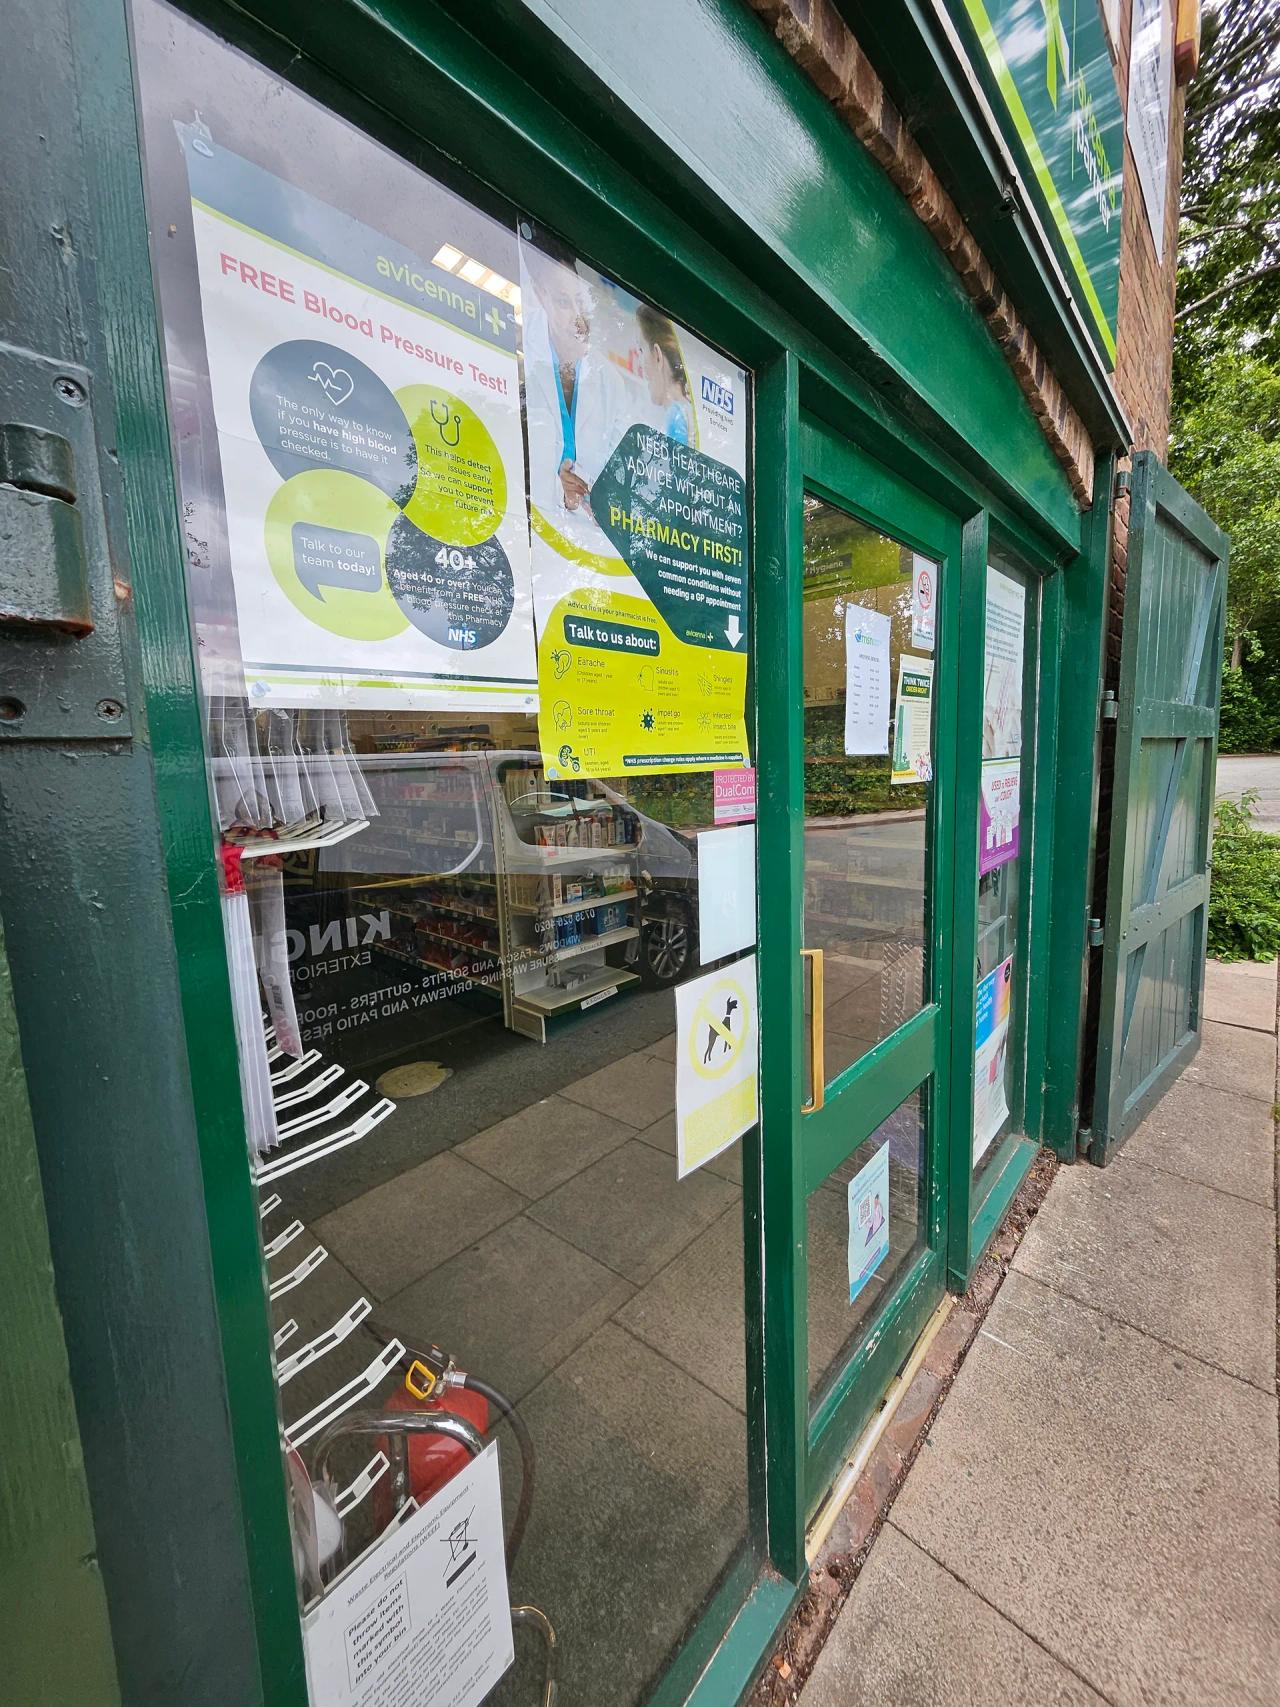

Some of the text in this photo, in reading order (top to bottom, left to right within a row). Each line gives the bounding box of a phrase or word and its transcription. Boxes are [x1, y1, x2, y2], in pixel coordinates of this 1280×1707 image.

[375, 255, 477, 319] avicenna
[219, 252, 508, 396] FREE Blood Pressure Test!
[702, 377, 733, 413] NHS
[277, 395, 393, 441] The only way to know
[277, 408, 397, 455] if you have high blood
[279, 425, 388, 464] pressure is to have it
[281, 439, 331, 461] checked.
[425, 444, 491, 472] This helps detect
[637, 432, 741, 494] NEED HEALTHCARE
[447, 464, 471, 480] issues
[438, 484, 495, 508] you to prevent
[447, 474, 461, 485] can
[463, 478, 493, 495] support
[628, 456, 742, 516] ADVICE WITHOUT AN
[454, 500, 478, 513] future
[659, 497, 742, 538] APPOINTMENT?
[301, 536, 366, 559] Talk to our
[609, 506, 742, 567] PHARMACY FIRST!
[302, 554, 376, 577] team today!
[435, 548, 477, 570] 40+
[645, 549, 742, 585] We can support you with seven
[393, 569, 418, 582] Aged
[420, 572, 434, 583] 40
[435, 576, 445, 585] or
[447, 577, 470, 589] over?
[472, 582, 486, 592] You
[658, 570, 742, 598] common conditions without
[400, 582, 431, 596] benefit
[432, 586, 453, 598] from
[463, 592, 484, 602] FREE
[486, 594, 502, 605] NHS
[663, 586, 689, 601] needing
[695, 593, 705, 602] GP
[705, 597, 742, 611] appointment
[434, 600, 469, 613] pressure
[471, 603, 493, 616] check
[495, 607, 503, 615] at
[448, 611, 463, 621] this
[567, 600, 588, 611] Advice
[602, 608, 615, 616] your
[615, 609, 641, 620] pharmacist
[448, 628, 476, 644] NHS
[569, 623, 657, 650] Talk to us about:
[685, 629, 706, 639] avicenna
[577, 657, 605, 668] Earache
[577, 707, 615, 716] Sore throat
[583, 747, 596, 756] UTI
[715, 774, 747, 784] PROTECTED
[716, 784, 755, 798] DualCom
[348, 1581, 367, 1605] Waste
[348, 1579, 403, 1636] Please do not
[352, 1594, 402, 1646] throw items
[353, 1604, 404, 1660] marked with
[357, 1616, 403, 1668] this symbol
[355, 1626, 407, 1684] into your bin
